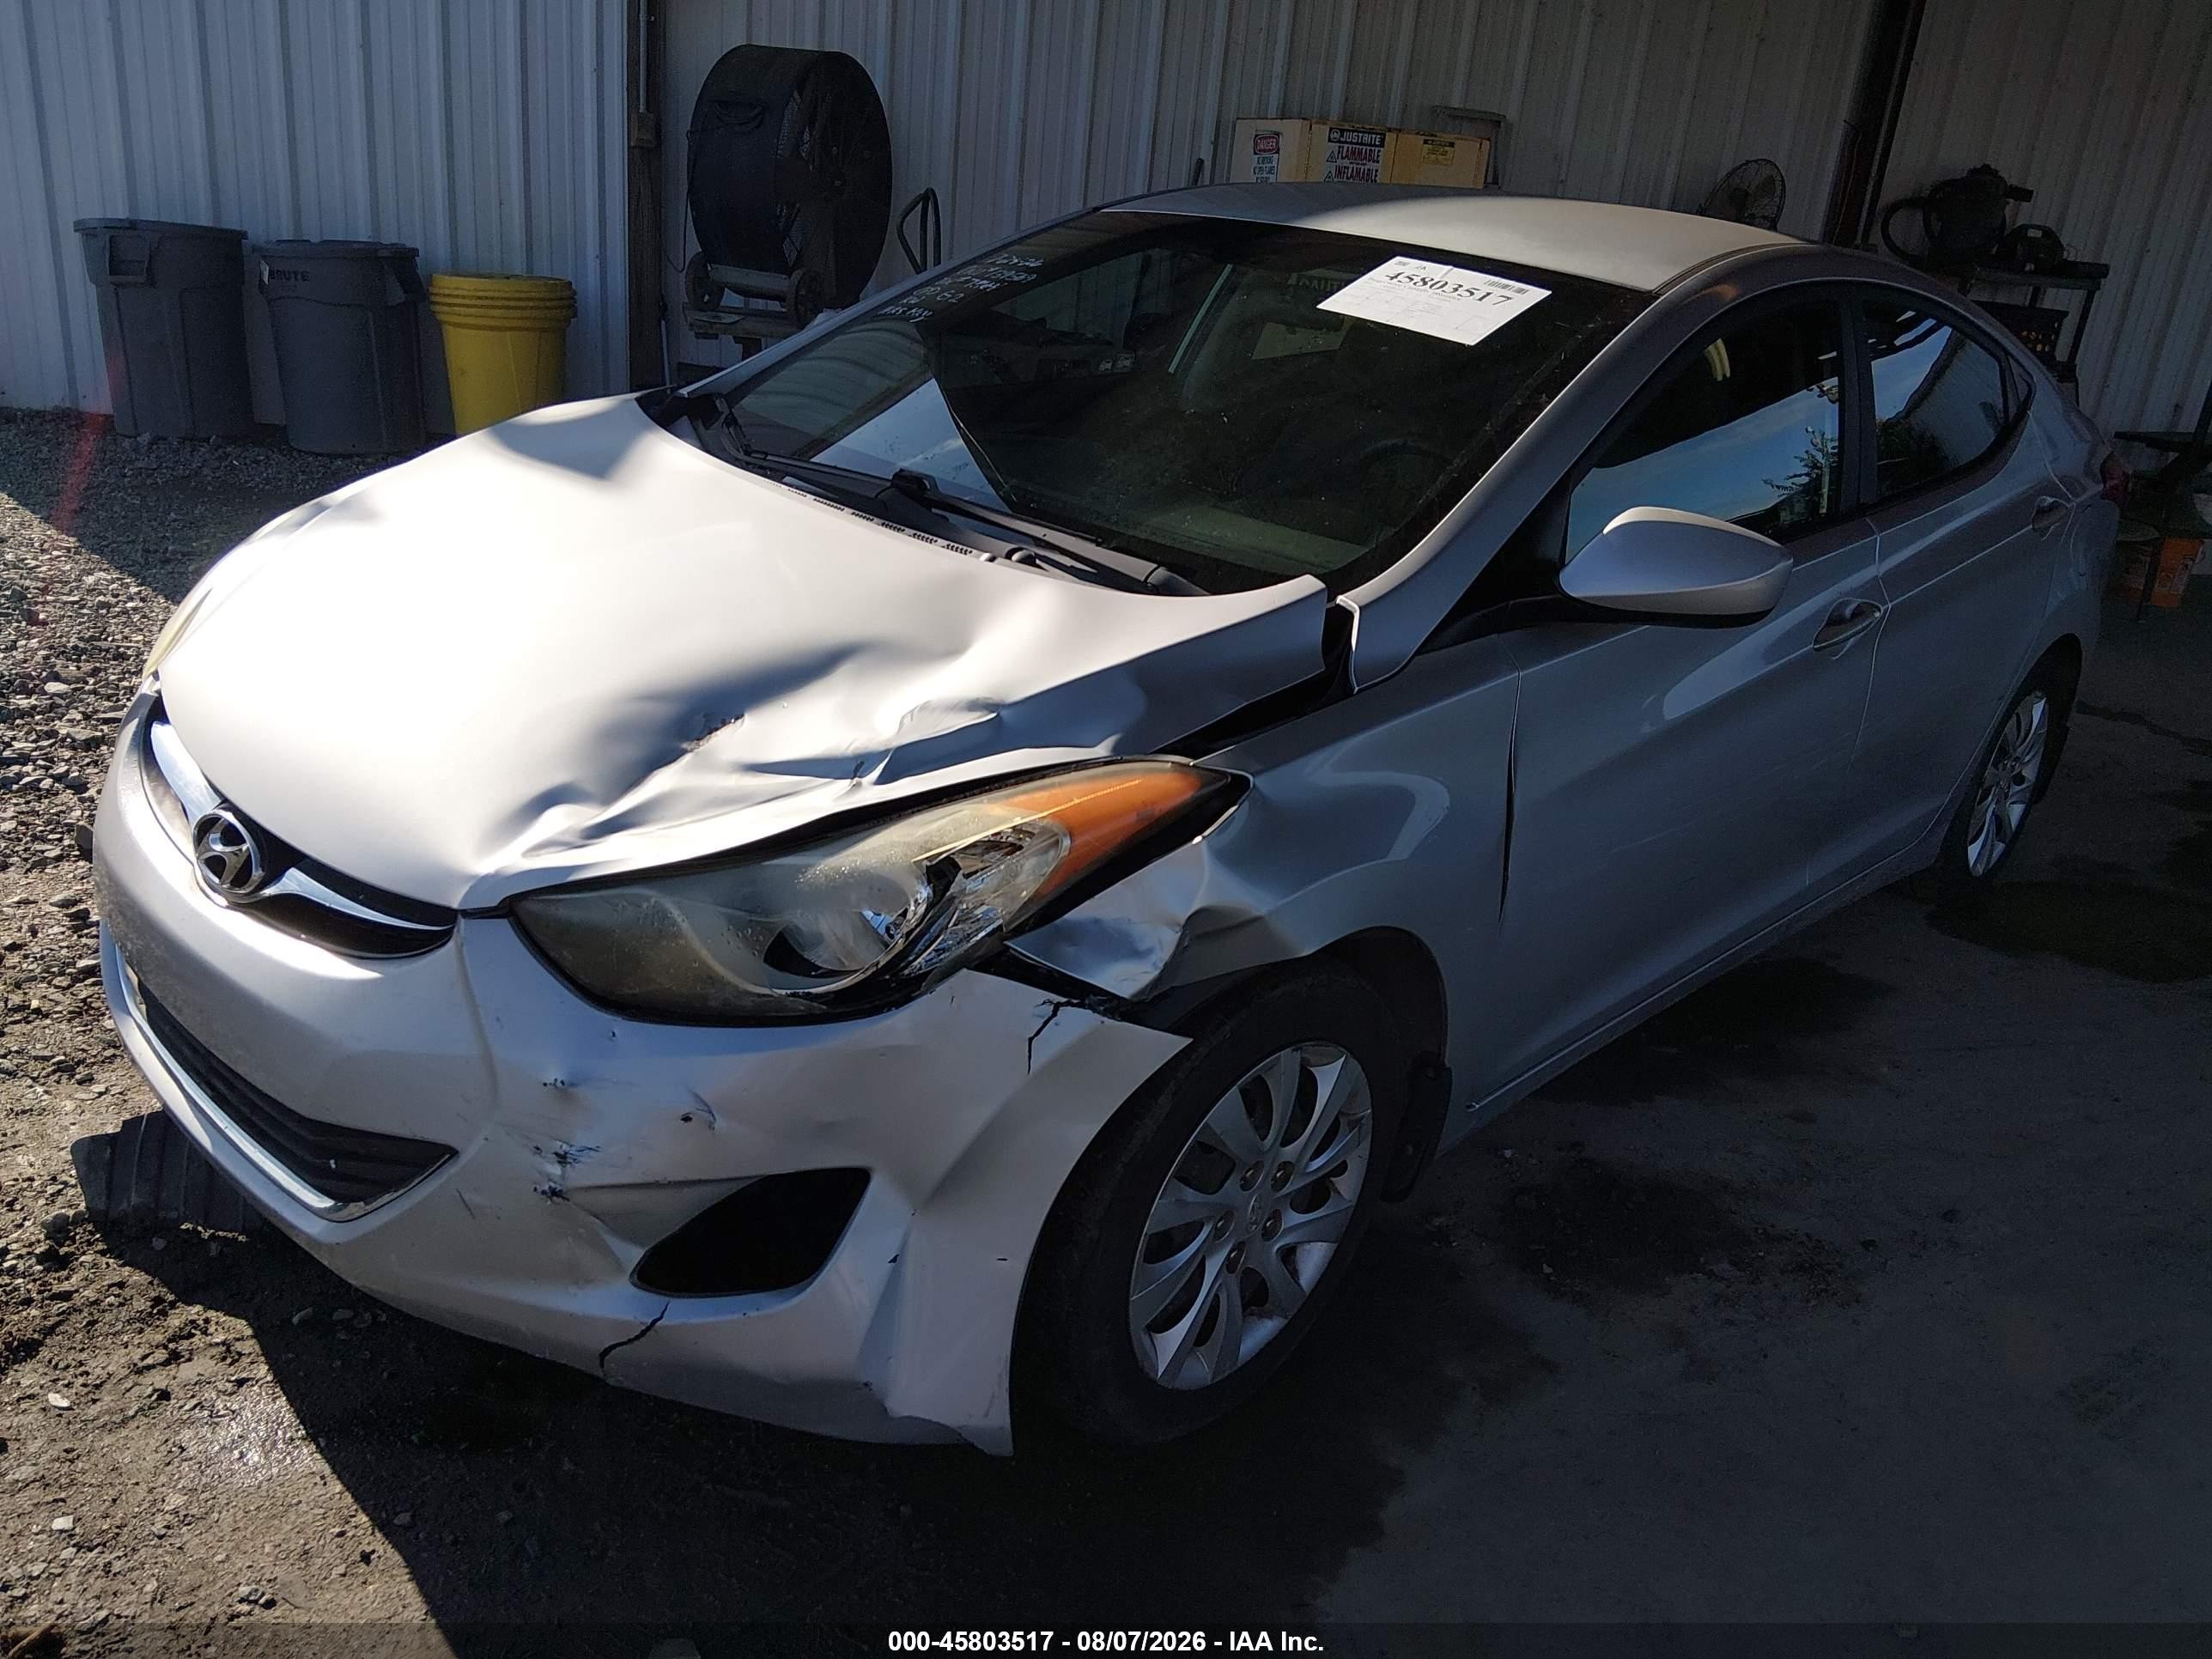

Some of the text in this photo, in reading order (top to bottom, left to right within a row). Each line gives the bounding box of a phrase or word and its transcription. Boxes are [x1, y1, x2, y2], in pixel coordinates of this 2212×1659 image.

[1340, 131, 1381, 145] JUSTRITE
[1337, 145, 1381, 163] FLAMMABLE
[1334, 164, 1378, 183] INFLAMABLE
[1385, 271, 1514, 306] 45803517
